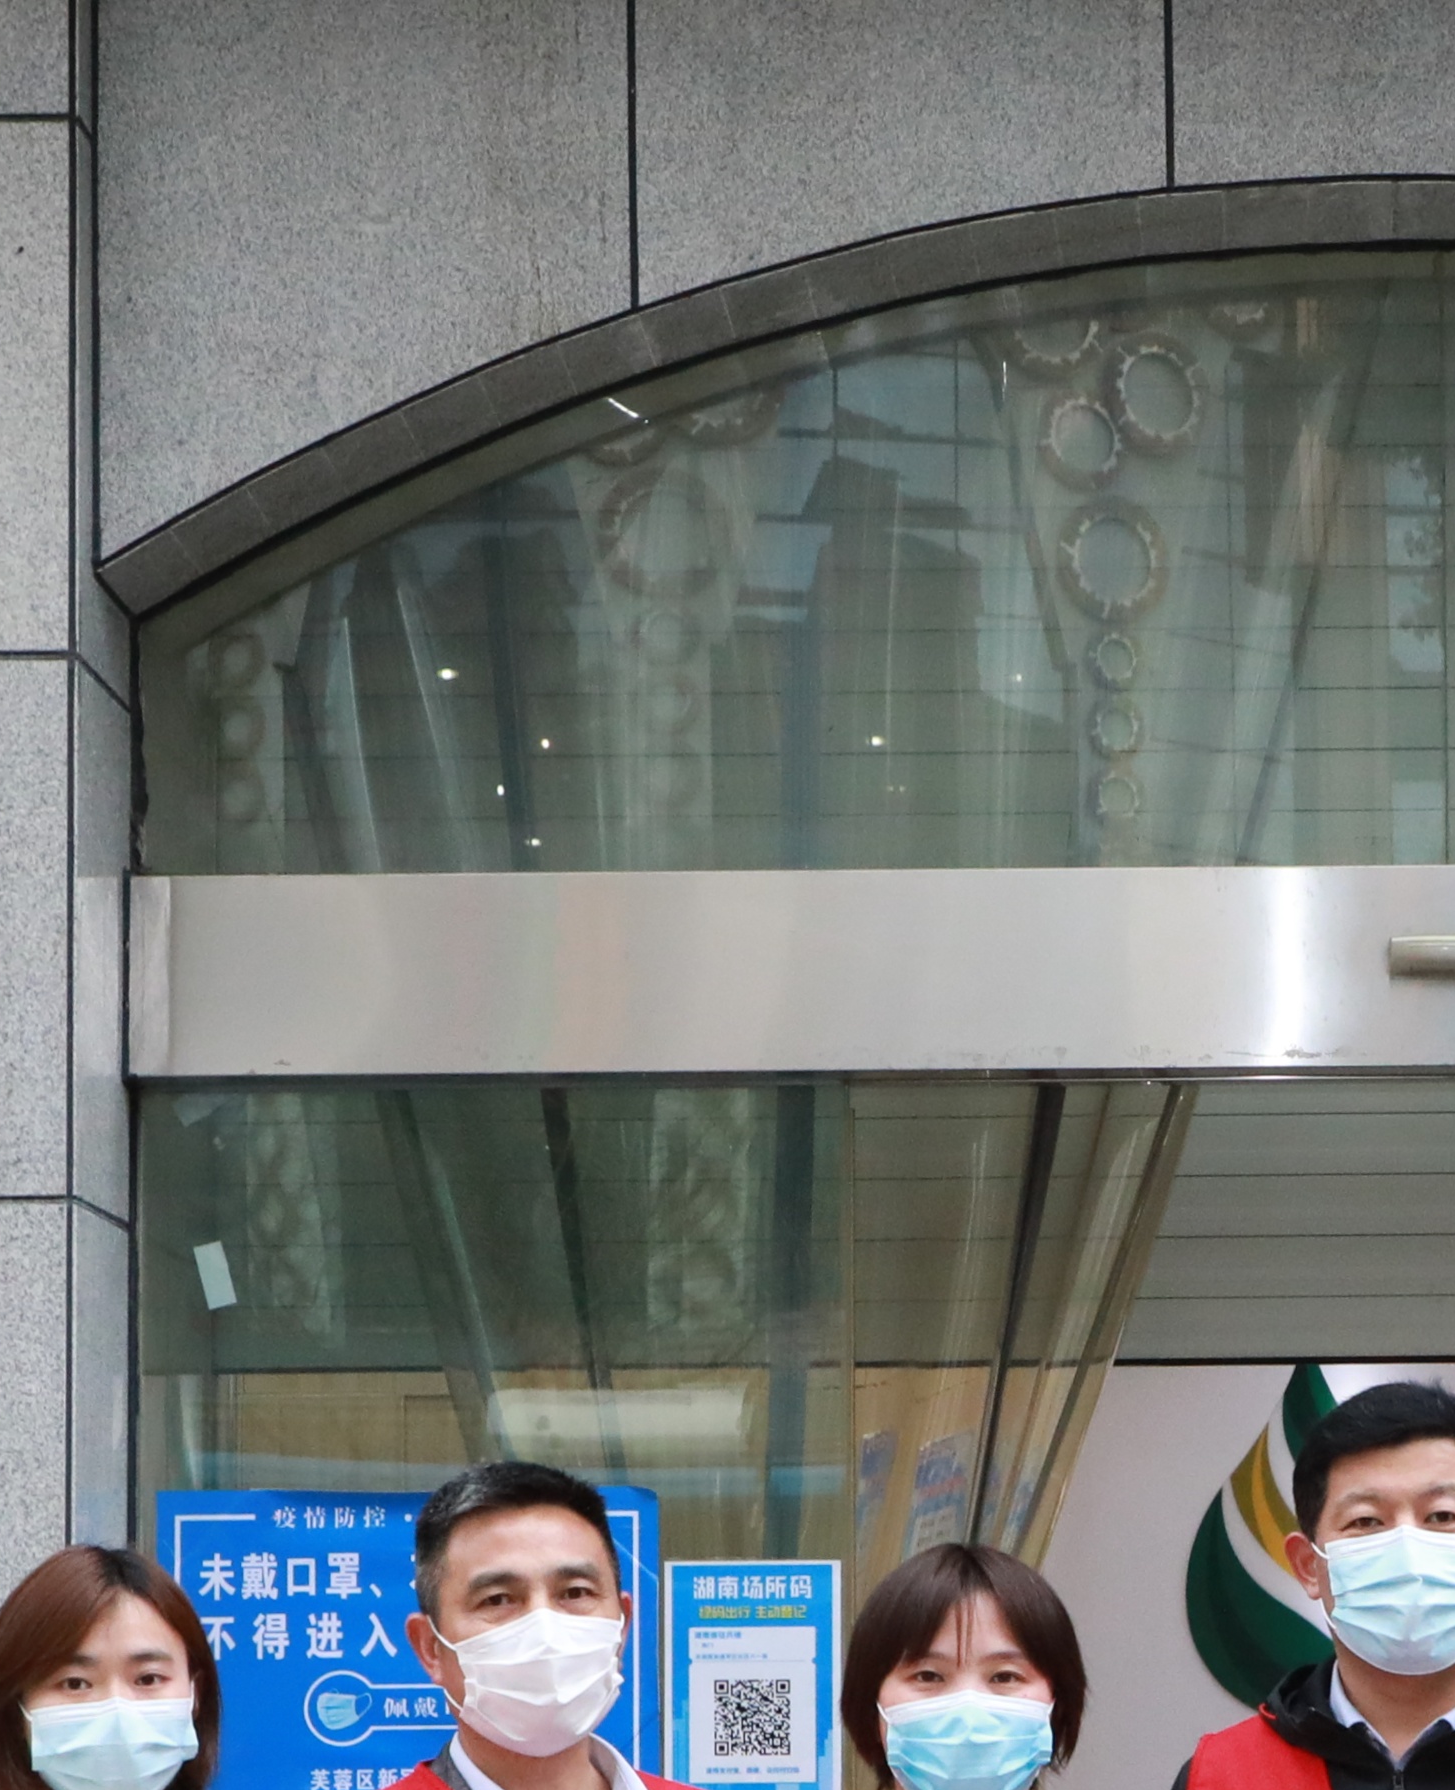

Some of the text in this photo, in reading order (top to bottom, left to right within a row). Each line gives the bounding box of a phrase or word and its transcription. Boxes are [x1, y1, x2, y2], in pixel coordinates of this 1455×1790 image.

[198, 1552, 415, 1600] 未戴口罩、
[693, 1575, 813, 1599] 湖南场所码
[199, 1611, 398, 1661] 不得进入
[383, 1697, 450, 1718] 佩戴
